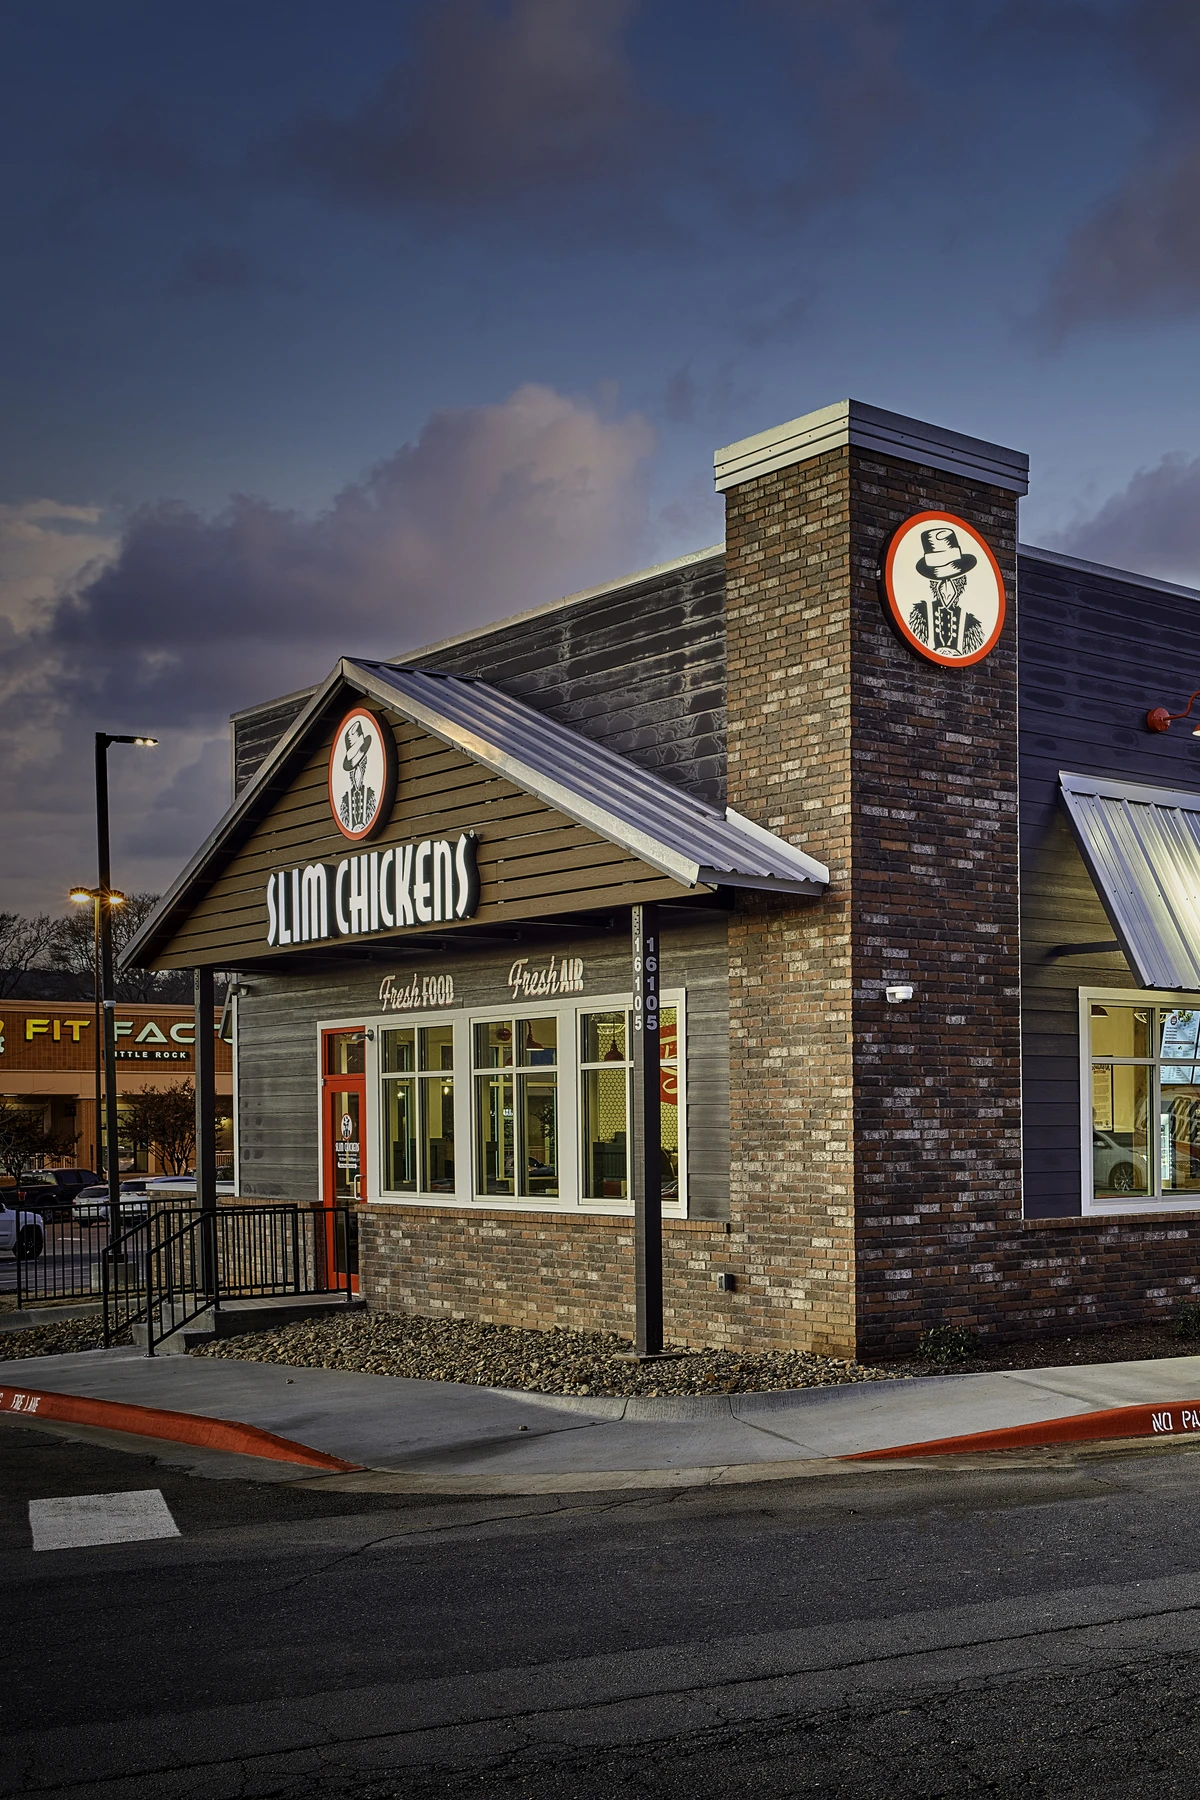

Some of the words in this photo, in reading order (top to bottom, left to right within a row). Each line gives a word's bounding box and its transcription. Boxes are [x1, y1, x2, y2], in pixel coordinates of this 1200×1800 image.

[266, 862, 328, 947] SLIM
[335, 832, 469, 935] CHICKENS
[379, 973, 421, 1012] Fresh
[422, 974, 455, 1008] FOOD
[508, 955, 560, 1000] Fresh
[559, 957, 584, 993] AIR
[634, 937, 642, 1031] 16105
[645, 937, 658, 1031] 16105
[25, 1019, 91, 1041] FIT
[114, 1051, 149, 1059] ITTLE
[155, 1051, 187, 1059] ROCK
[1151, 1412, 1173, 1433] NO
